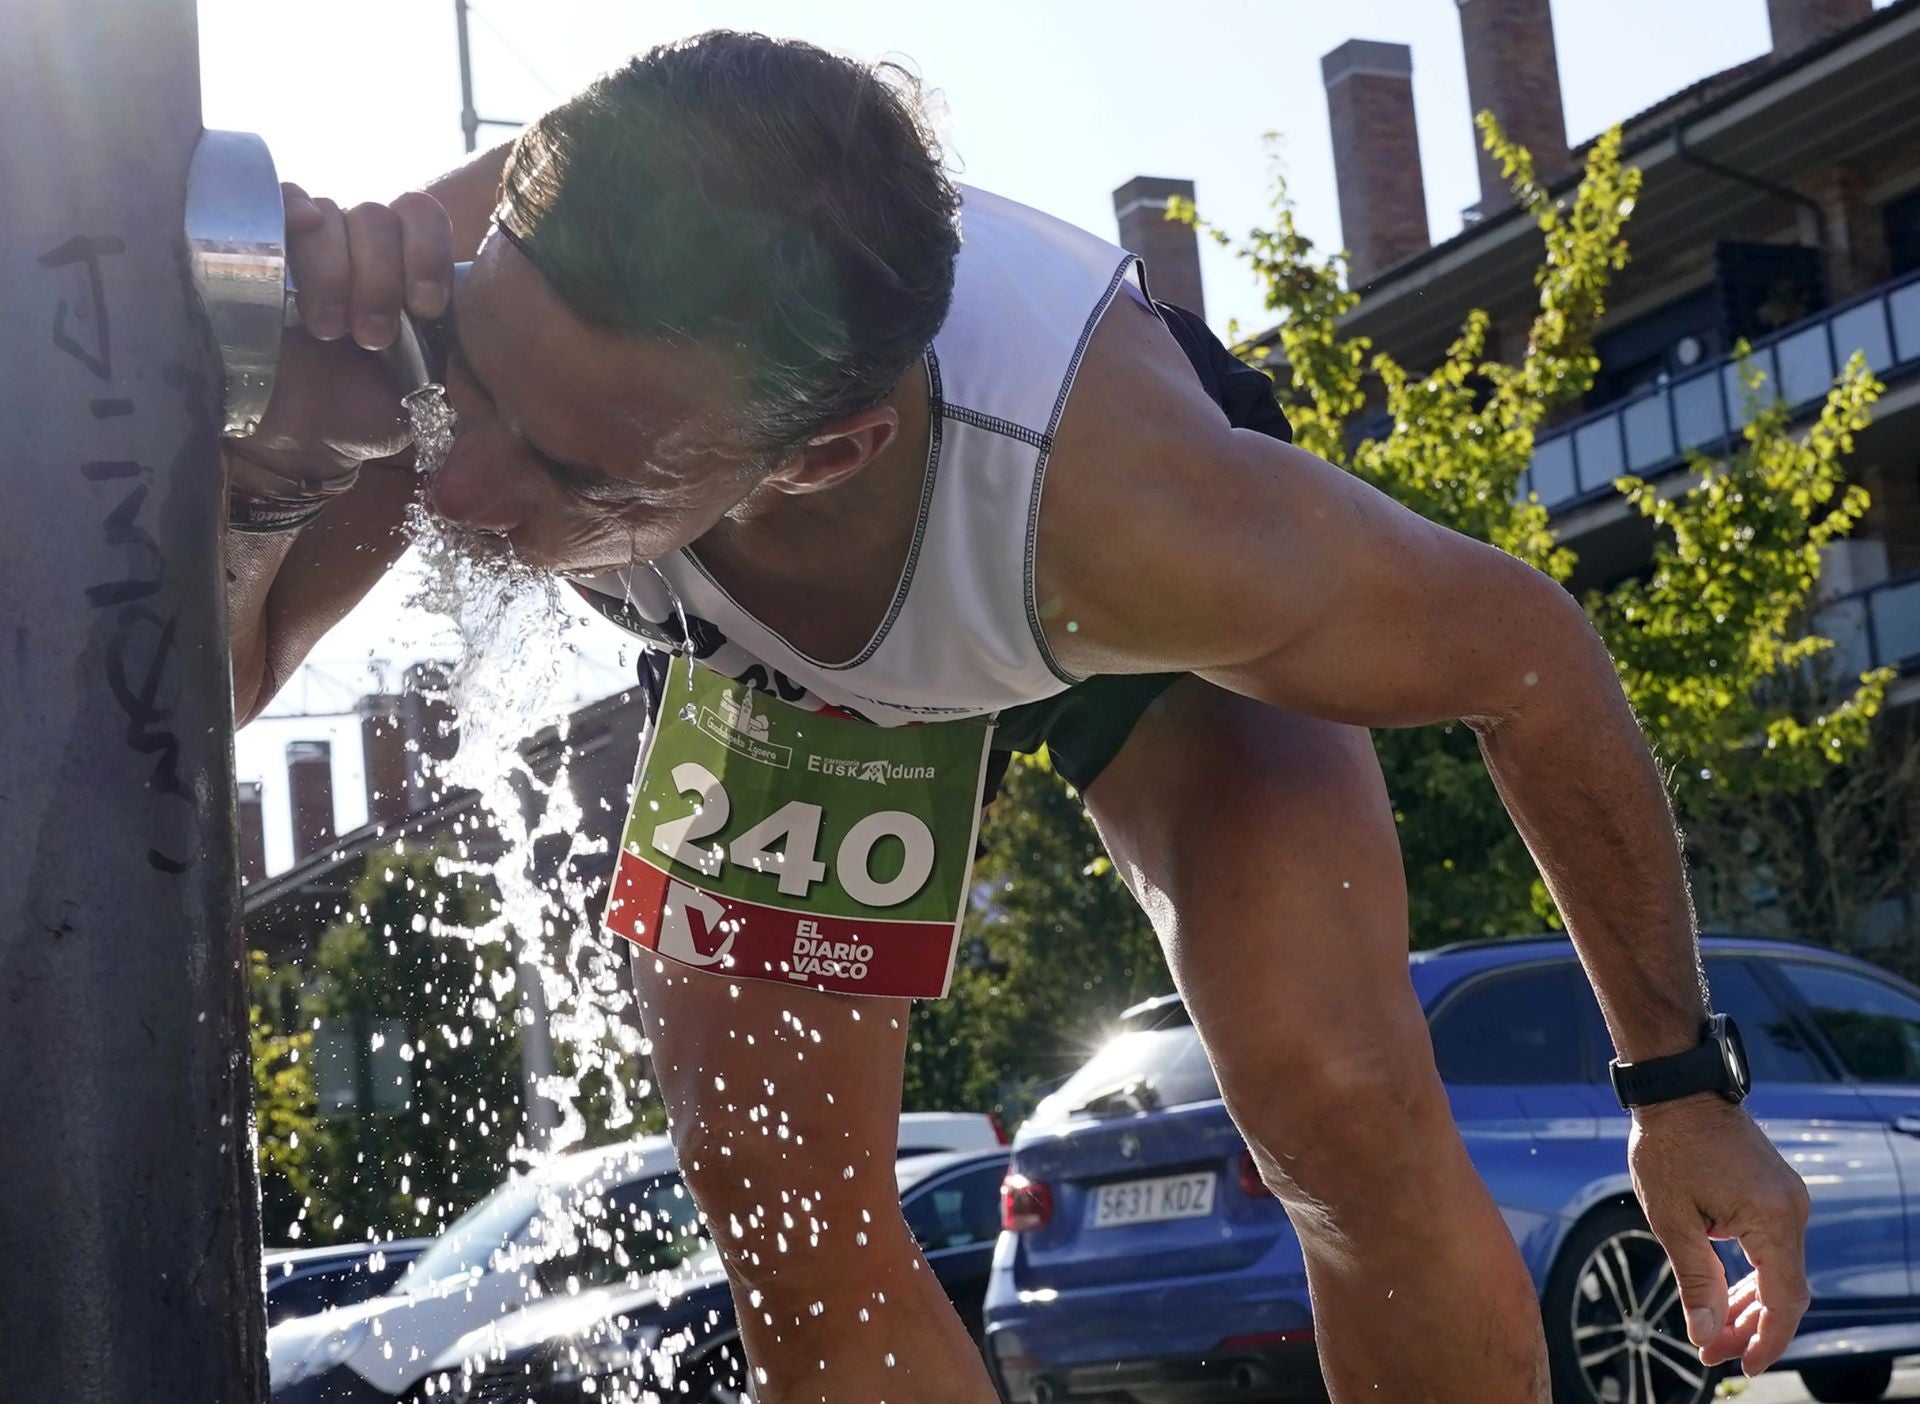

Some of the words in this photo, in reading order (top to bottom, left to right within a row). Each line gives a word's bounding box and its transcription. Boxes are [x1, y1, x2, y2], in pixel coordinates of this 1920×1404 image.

[652, 762, 935, 907] 240
[796, 920, 823, 940] EL
[793, 937, 874, 962] DIARIO
[792, 955, 868, 980] VASCO
